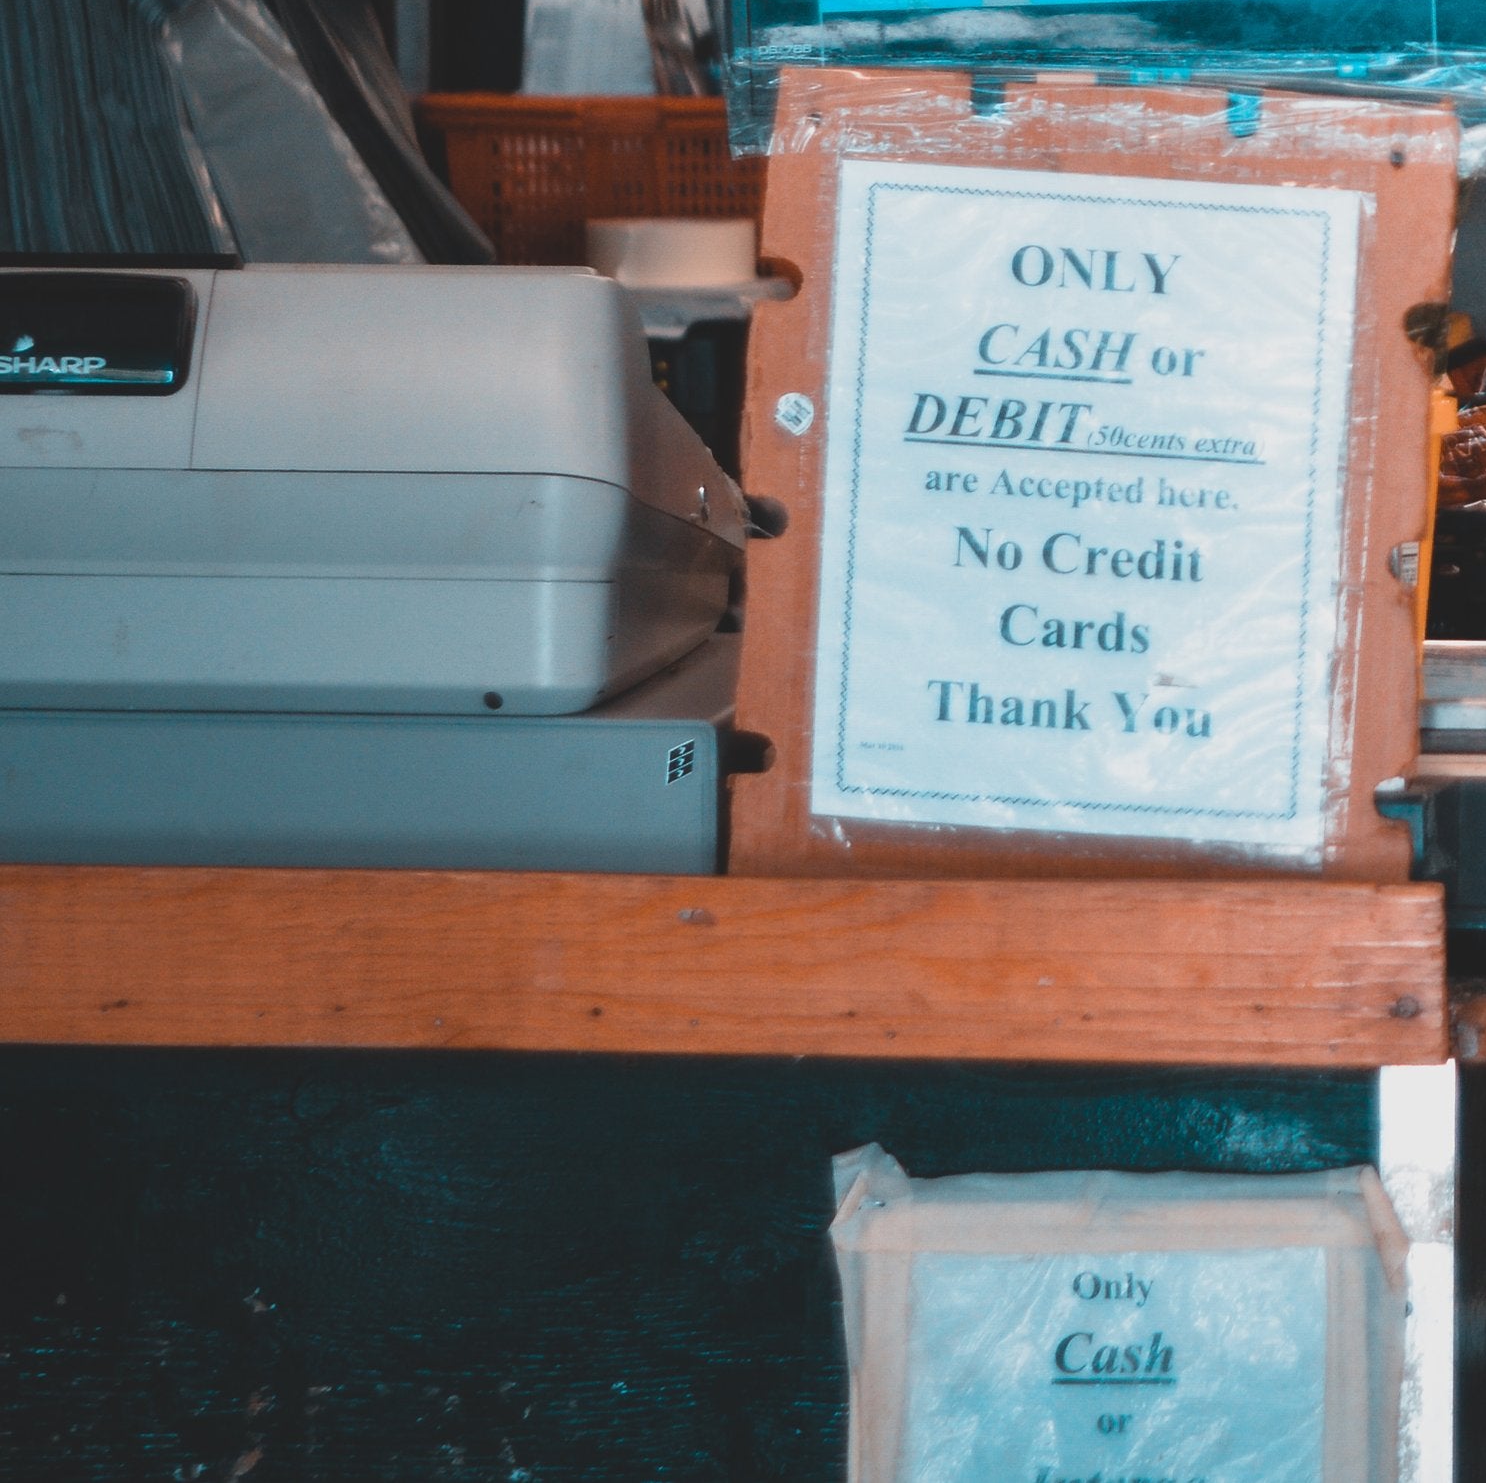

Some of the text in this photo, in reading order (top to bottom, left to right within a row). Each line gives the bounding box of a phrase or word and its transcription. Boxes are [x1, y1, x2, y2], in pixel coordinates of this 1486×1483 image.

[1010, 244, 1182, 295] ONLY
[0, 355, 107, 375] SHARP
[977, 323, 1206, 377] CASH or
[904, 392, 1093, 445] DEBIT
[925, 468, 1241, 510] are Accepted here.
[952, 526, 1205, 583] No Credit
[999, 603, 1151, 654] Cards
[927, 679, 1213, 738] Thank You
[1072, 1270, 1155, 1308] Only
[1054, 1330, 1175, 1376] Cash
[1096, 1413, 1133, 1435] or
